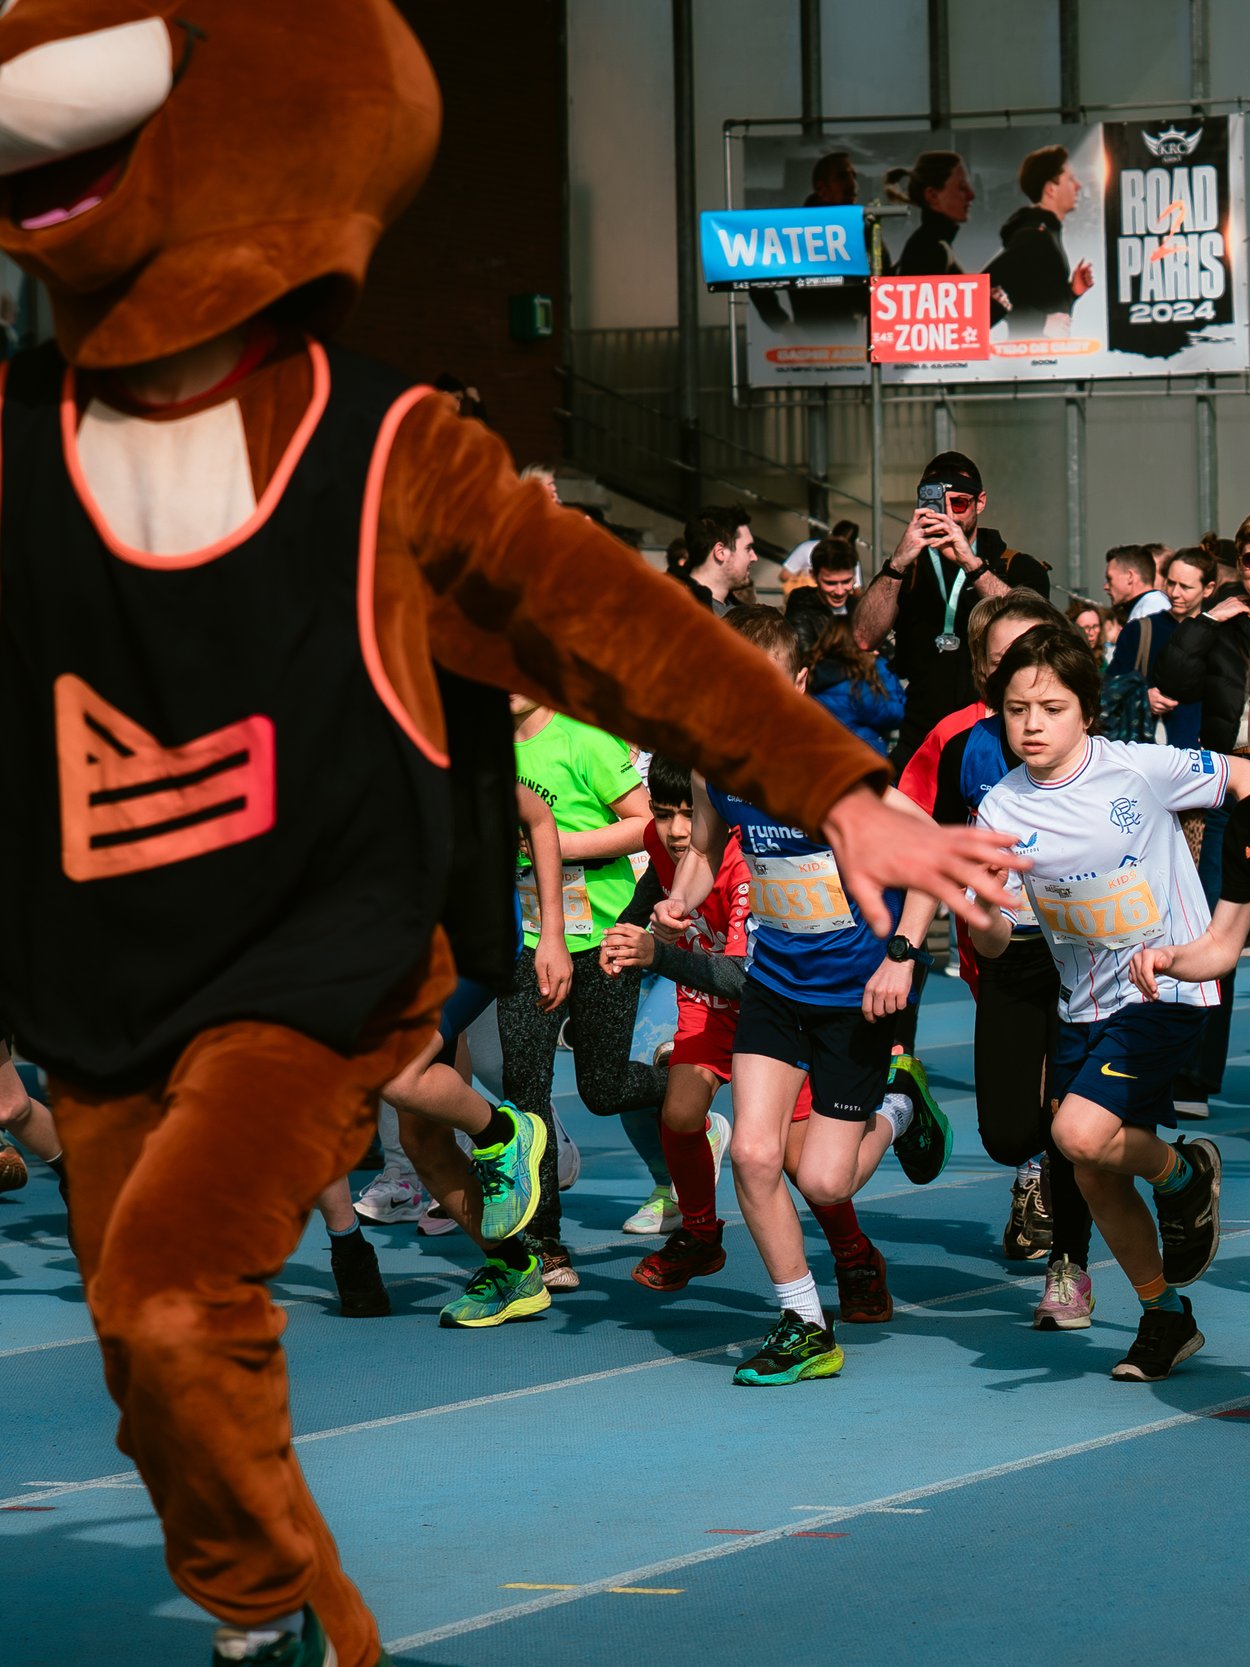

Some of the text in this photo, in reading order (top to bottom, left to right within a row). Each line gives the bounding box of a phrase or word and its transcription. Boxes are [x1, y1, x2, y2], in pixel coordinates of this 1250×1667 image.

[1120, 165, 1218, 236] ROAD
[718, 225, 851, 267] WATER
[1118, 232, 1225, 304] PARIS
[876, 282, 978, 320] START
[1129, 301, 1216, 325] 2024
[894, 323, 960, 352] ZONE
[747, 824, 809, 839] runne
[800, 859, 830, 873] KIDS
[1107, 870, 1138, 889] KIDS
[750, 879, 835, 917] 7031
[1043, 889, 1151, 936] 7076
